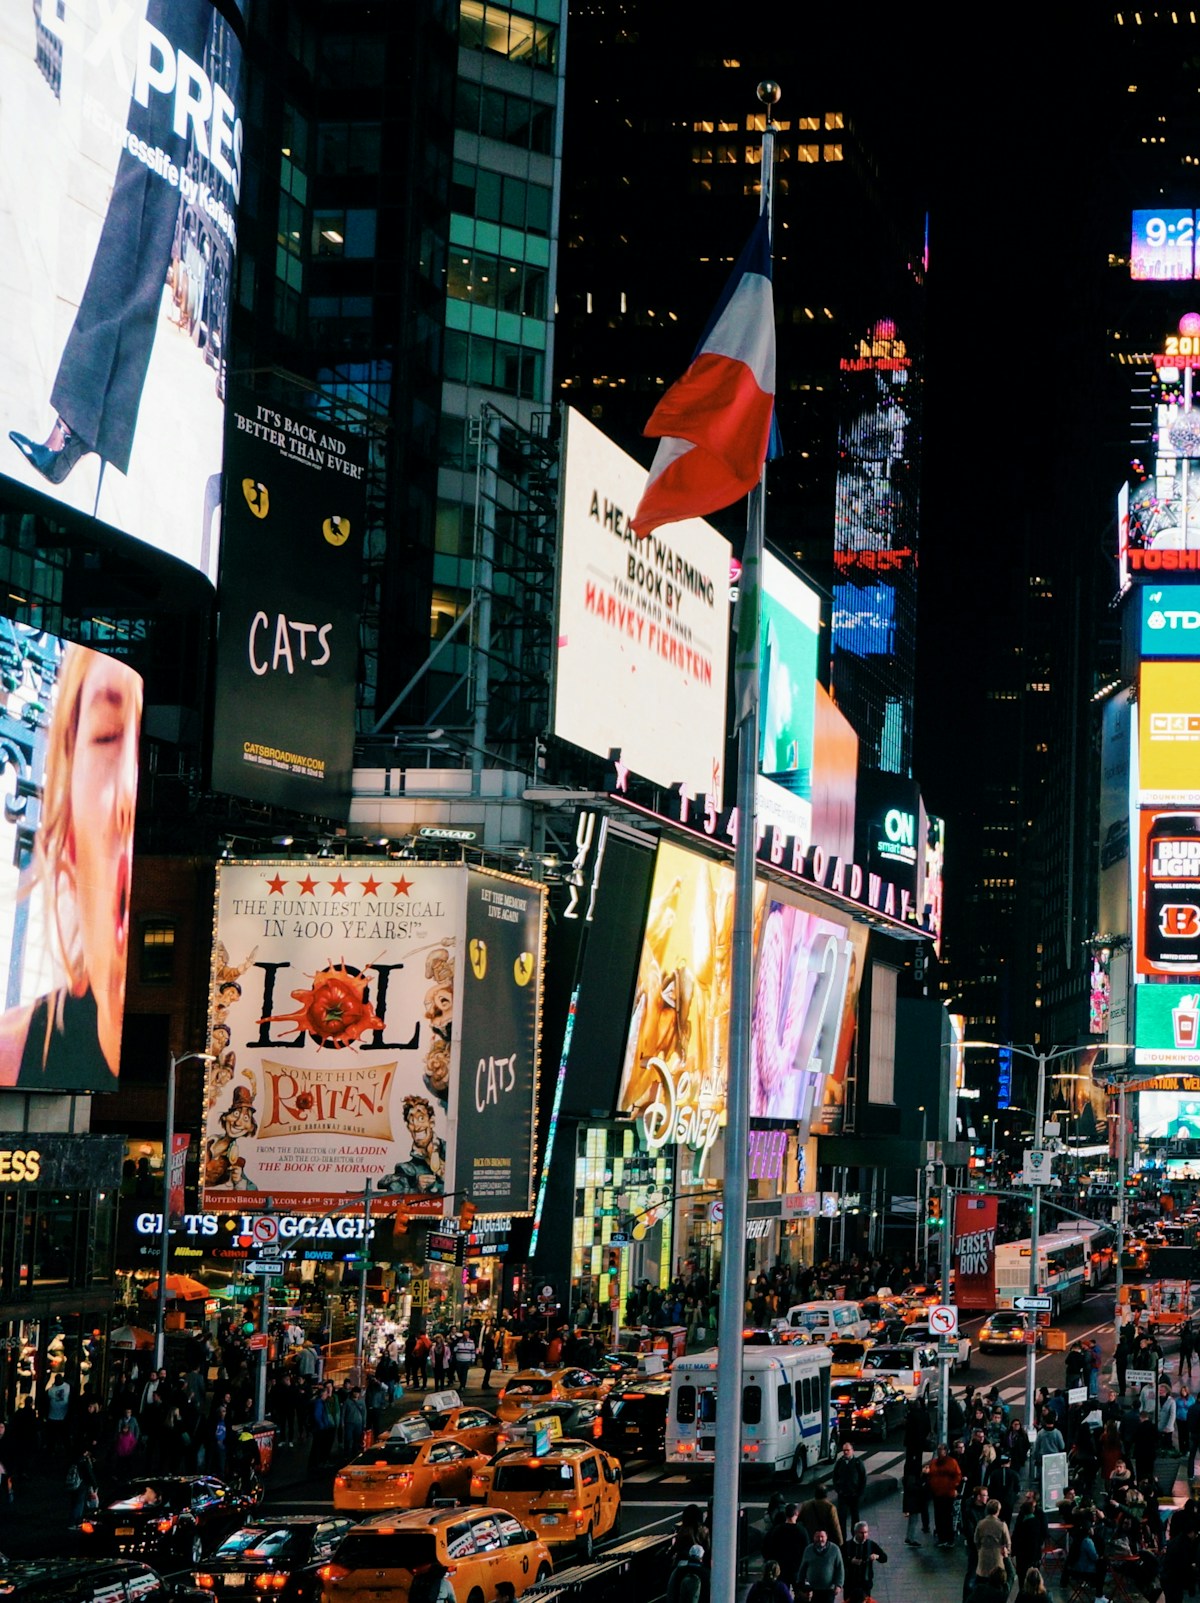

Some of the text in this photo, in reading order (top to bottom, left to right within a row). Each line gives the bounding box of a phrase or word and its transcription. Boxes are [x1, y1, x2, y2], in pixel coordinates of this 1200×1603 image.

[178, 166, 199, 205] by
[257, 405, 346, 456] IT'S BACK AND
[289, 437, 324, 465] THAN
[588, 487, 600, 523] A
[626, 551, 682, 614] BOOK BY
[614, 576, 692, 643] TONY AWARD WINNER
[248, 610, 333, 676] CATS
[585, 579, 712, 688] HARVEY FIERSTEIN
[243, 742, 325, 770] CATSBROADWAY.COM
[884, 809, 914, 845] ON
[770, 825, 911, 921] BROADWAY
[233, 899, 446, 917] THE FUNNIEST MUSICAL
[481, 888, 527, 912] LET THE MEMORY
[488, 905, 519, 923] LIVE AGAIN
[262, 919, 284, 937] IN
[293, 921, 333, 938] 400
[280, 1067, 377, 1082] SOMETHING
[475, 1053, 516, 1113] CATS
[256, 1145, 275, 1153] FROM
[339, 1146, 388, 1155] ALADDIN
[258, 1163, 386, 1173] THE BOOK OF MORMON
[472, 1218, 512, 1232] LUGGAGE
[174, 1246, 204, 1257] Nikon
[211, 1248, 248, 1258] Canon
[304, 1250, 334, 1260] BOWER
[481, 1245, 498, 1255] SONY
[955, 1231, 995, 1256] JERSEY
[960, 1253, 988, 1275] BOYS
[235, 1285, 253, 1295] W 46
[412, 1281, 421, 1303] ATM
